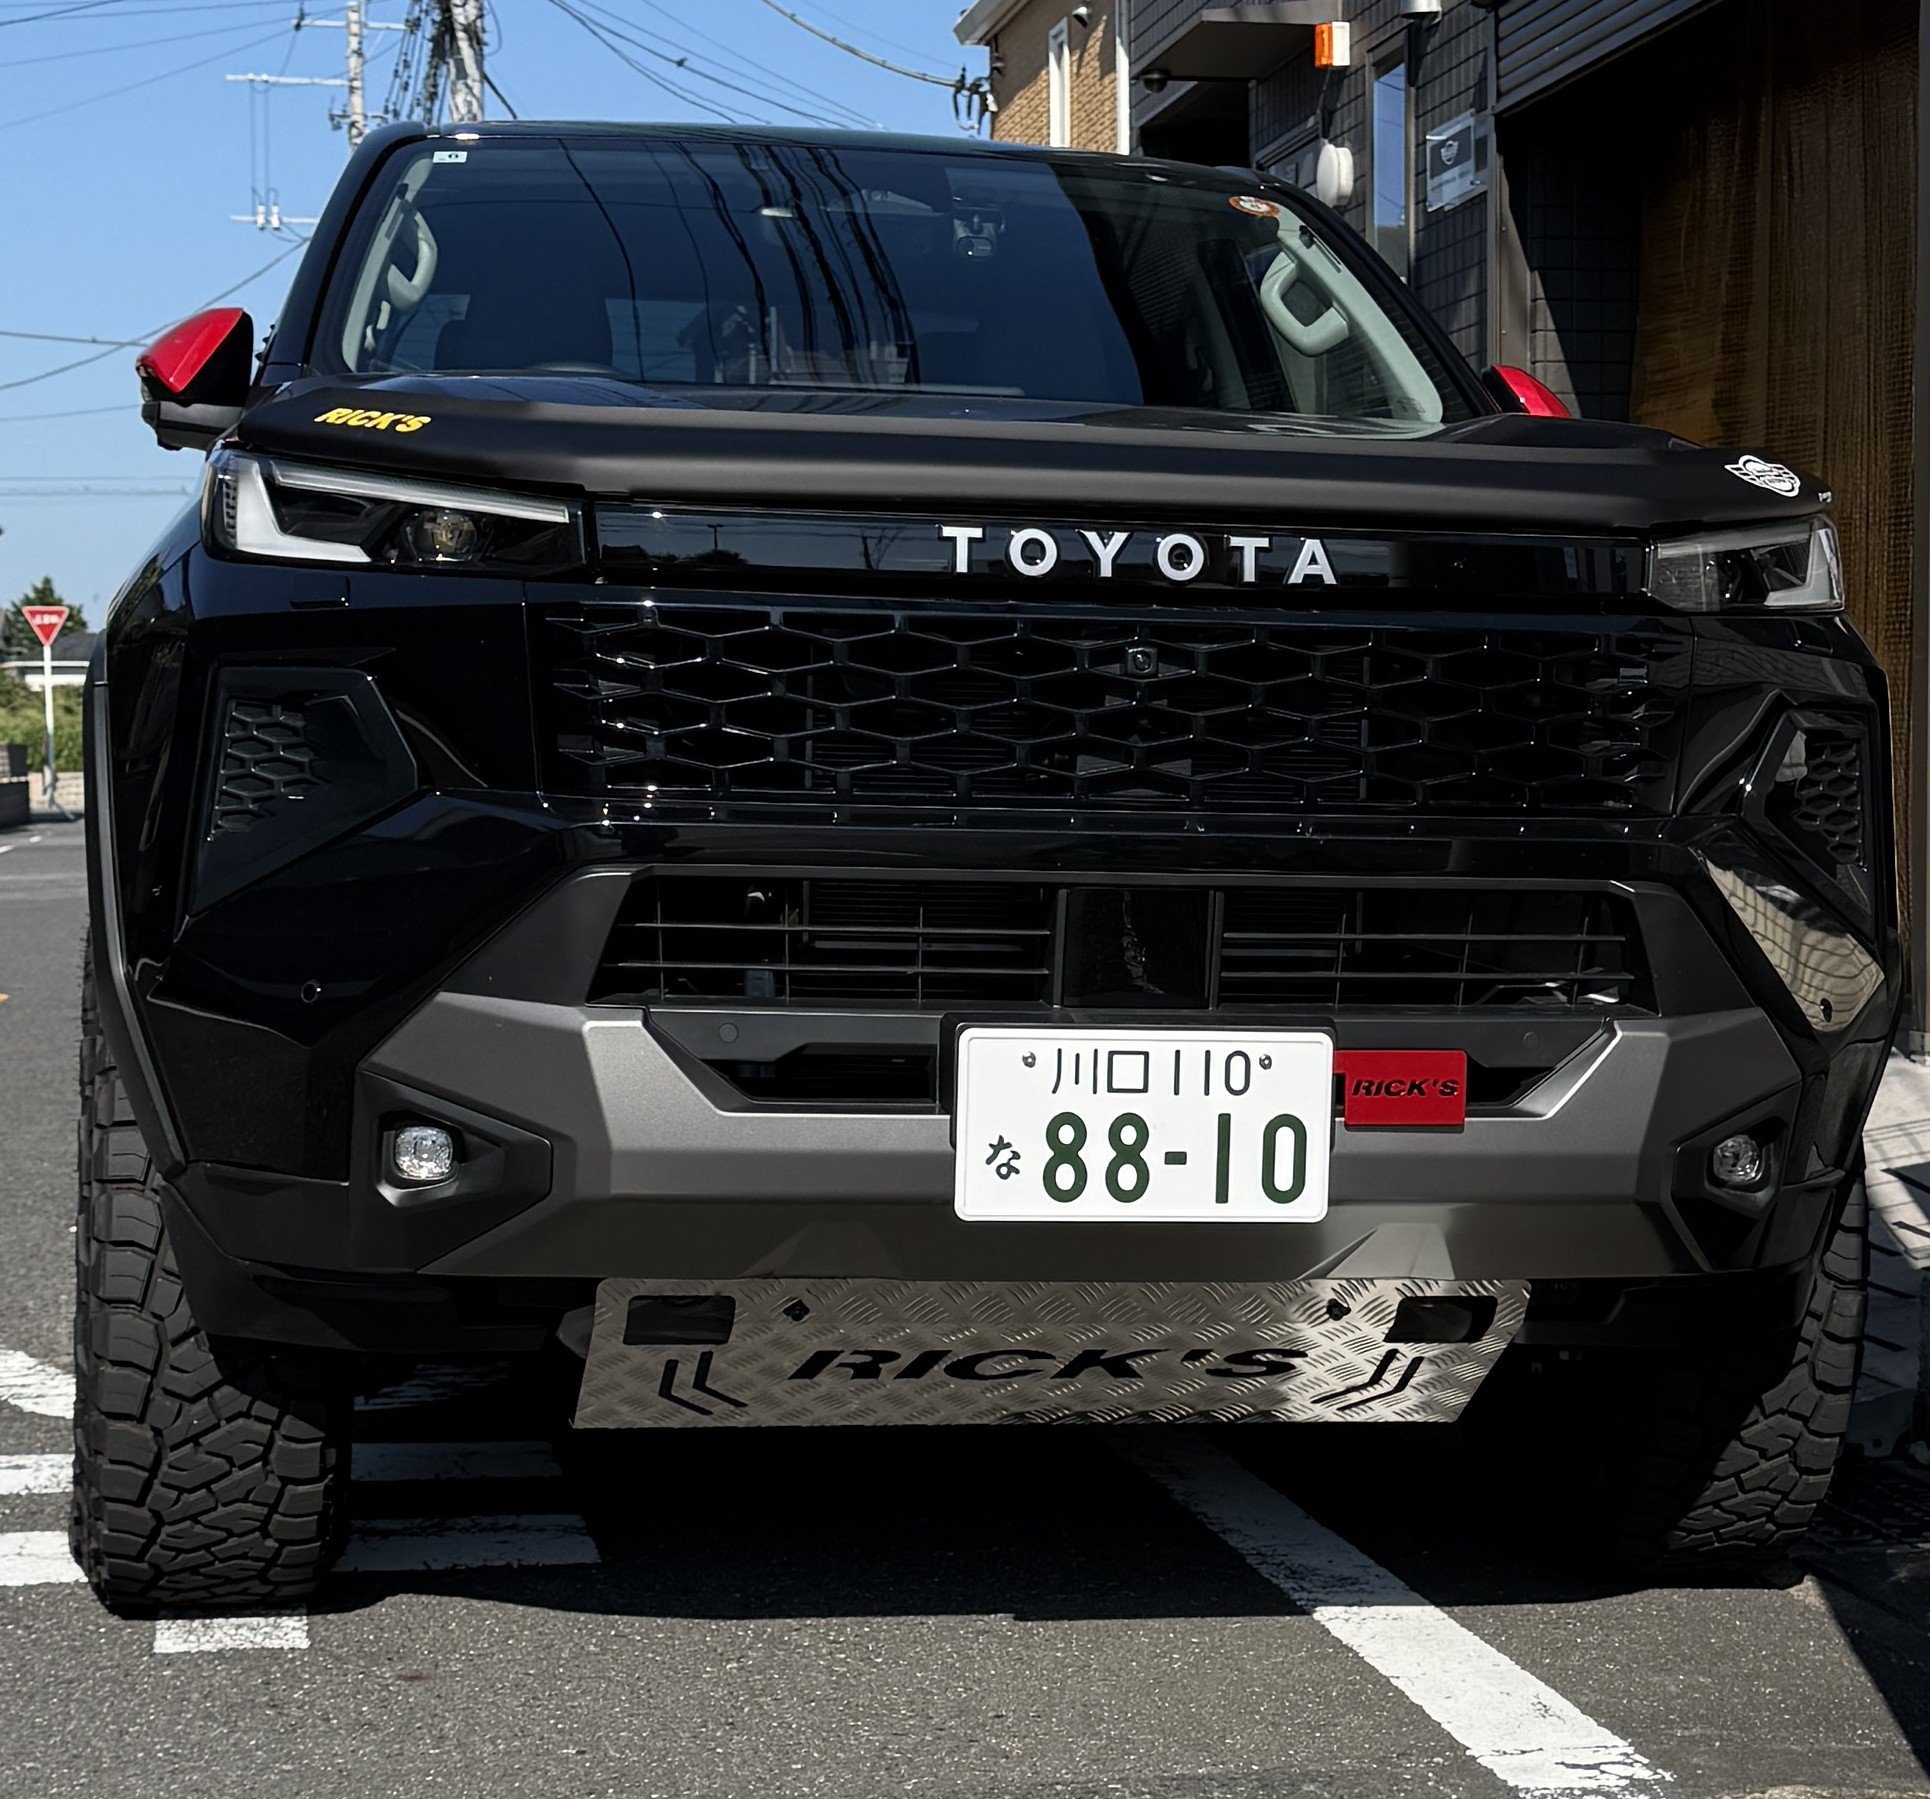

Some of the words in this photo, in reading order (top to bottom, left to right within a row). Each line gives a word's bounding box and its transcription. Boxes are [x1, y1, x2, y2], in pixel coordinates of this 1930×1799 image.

[314, 408, 432, 432] RICK'S
[940, 525, 1338, 586] TOYOTA
[1351, 1077, 1459, 1098] RICK'S
[985, 1134, 1022, 1180] な
[1042, 1111, 1308, 1203] 88-10
[789, 1348, 1308, 1381] RICK'S
